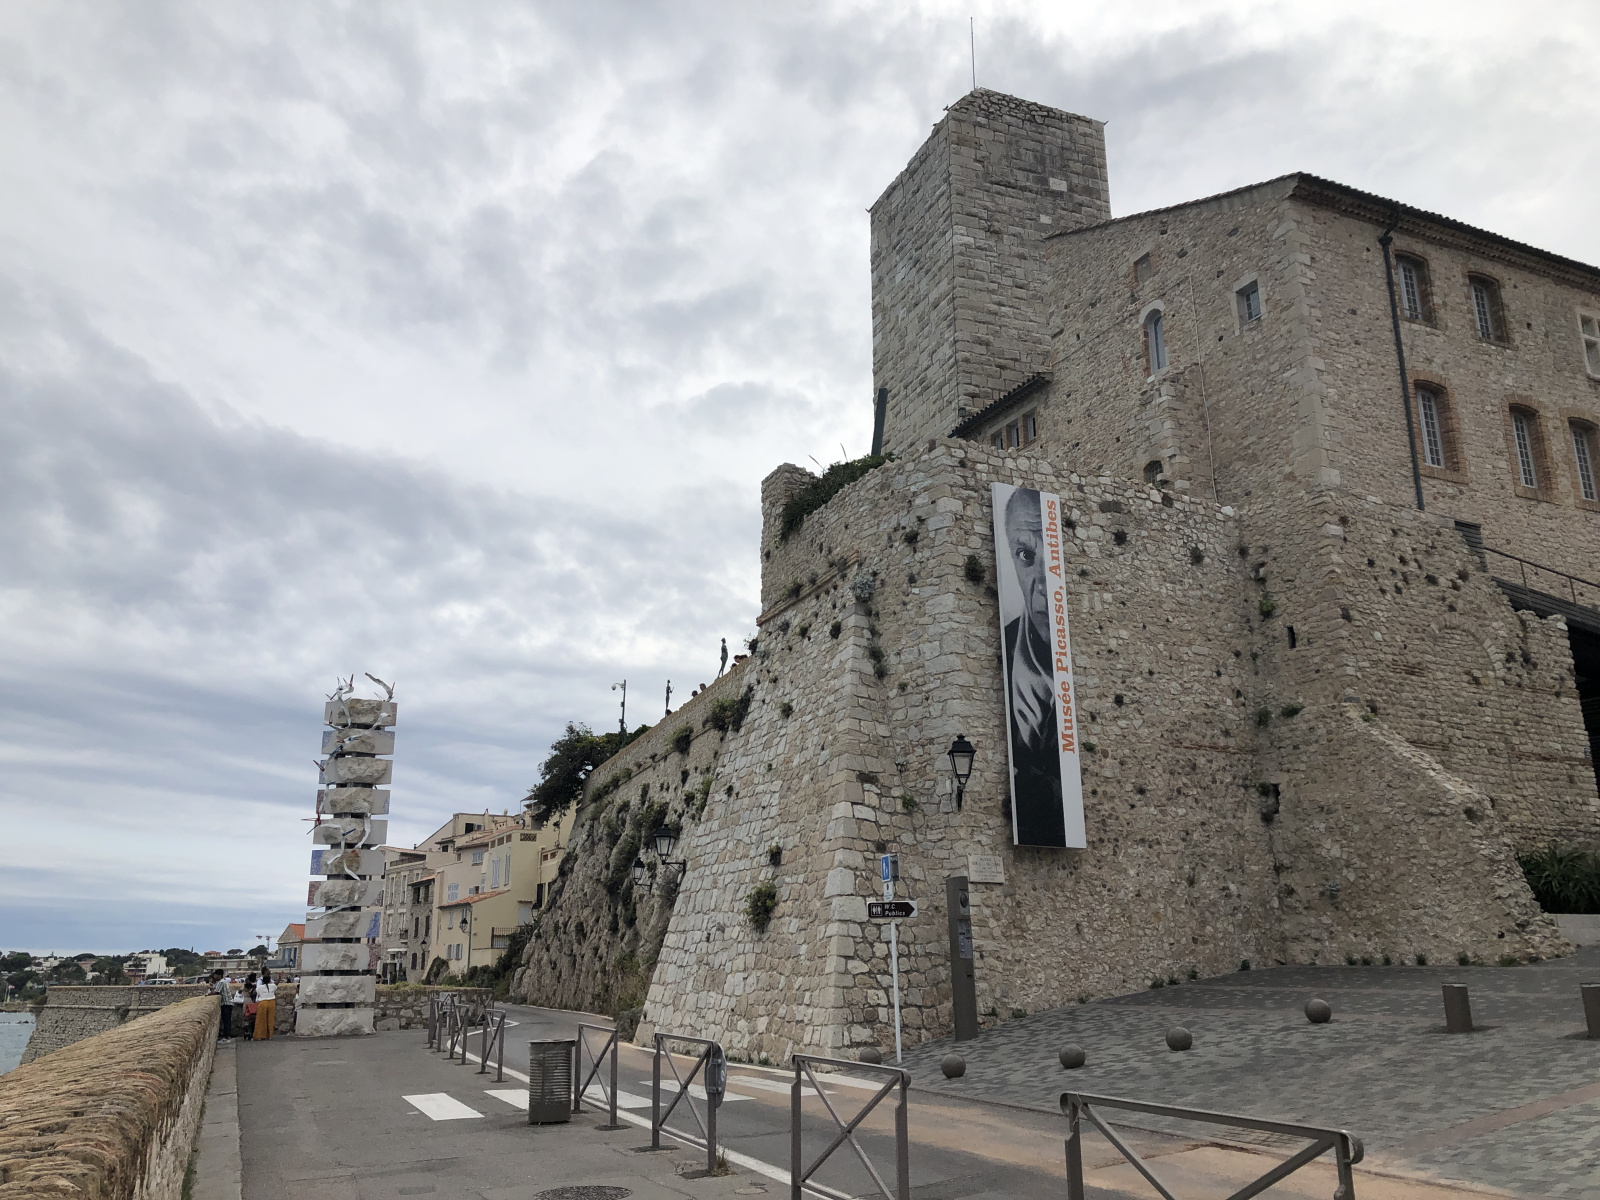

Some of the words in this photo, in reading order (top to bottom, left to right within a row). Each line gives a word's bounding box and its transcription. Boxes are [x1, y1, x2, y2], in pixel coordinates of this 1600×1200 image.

[1046, 500, 1062, 579] Antibes
[1053, 585, 1069, 674] Picasso,
[1057, 681, 1076, 754] Musée
